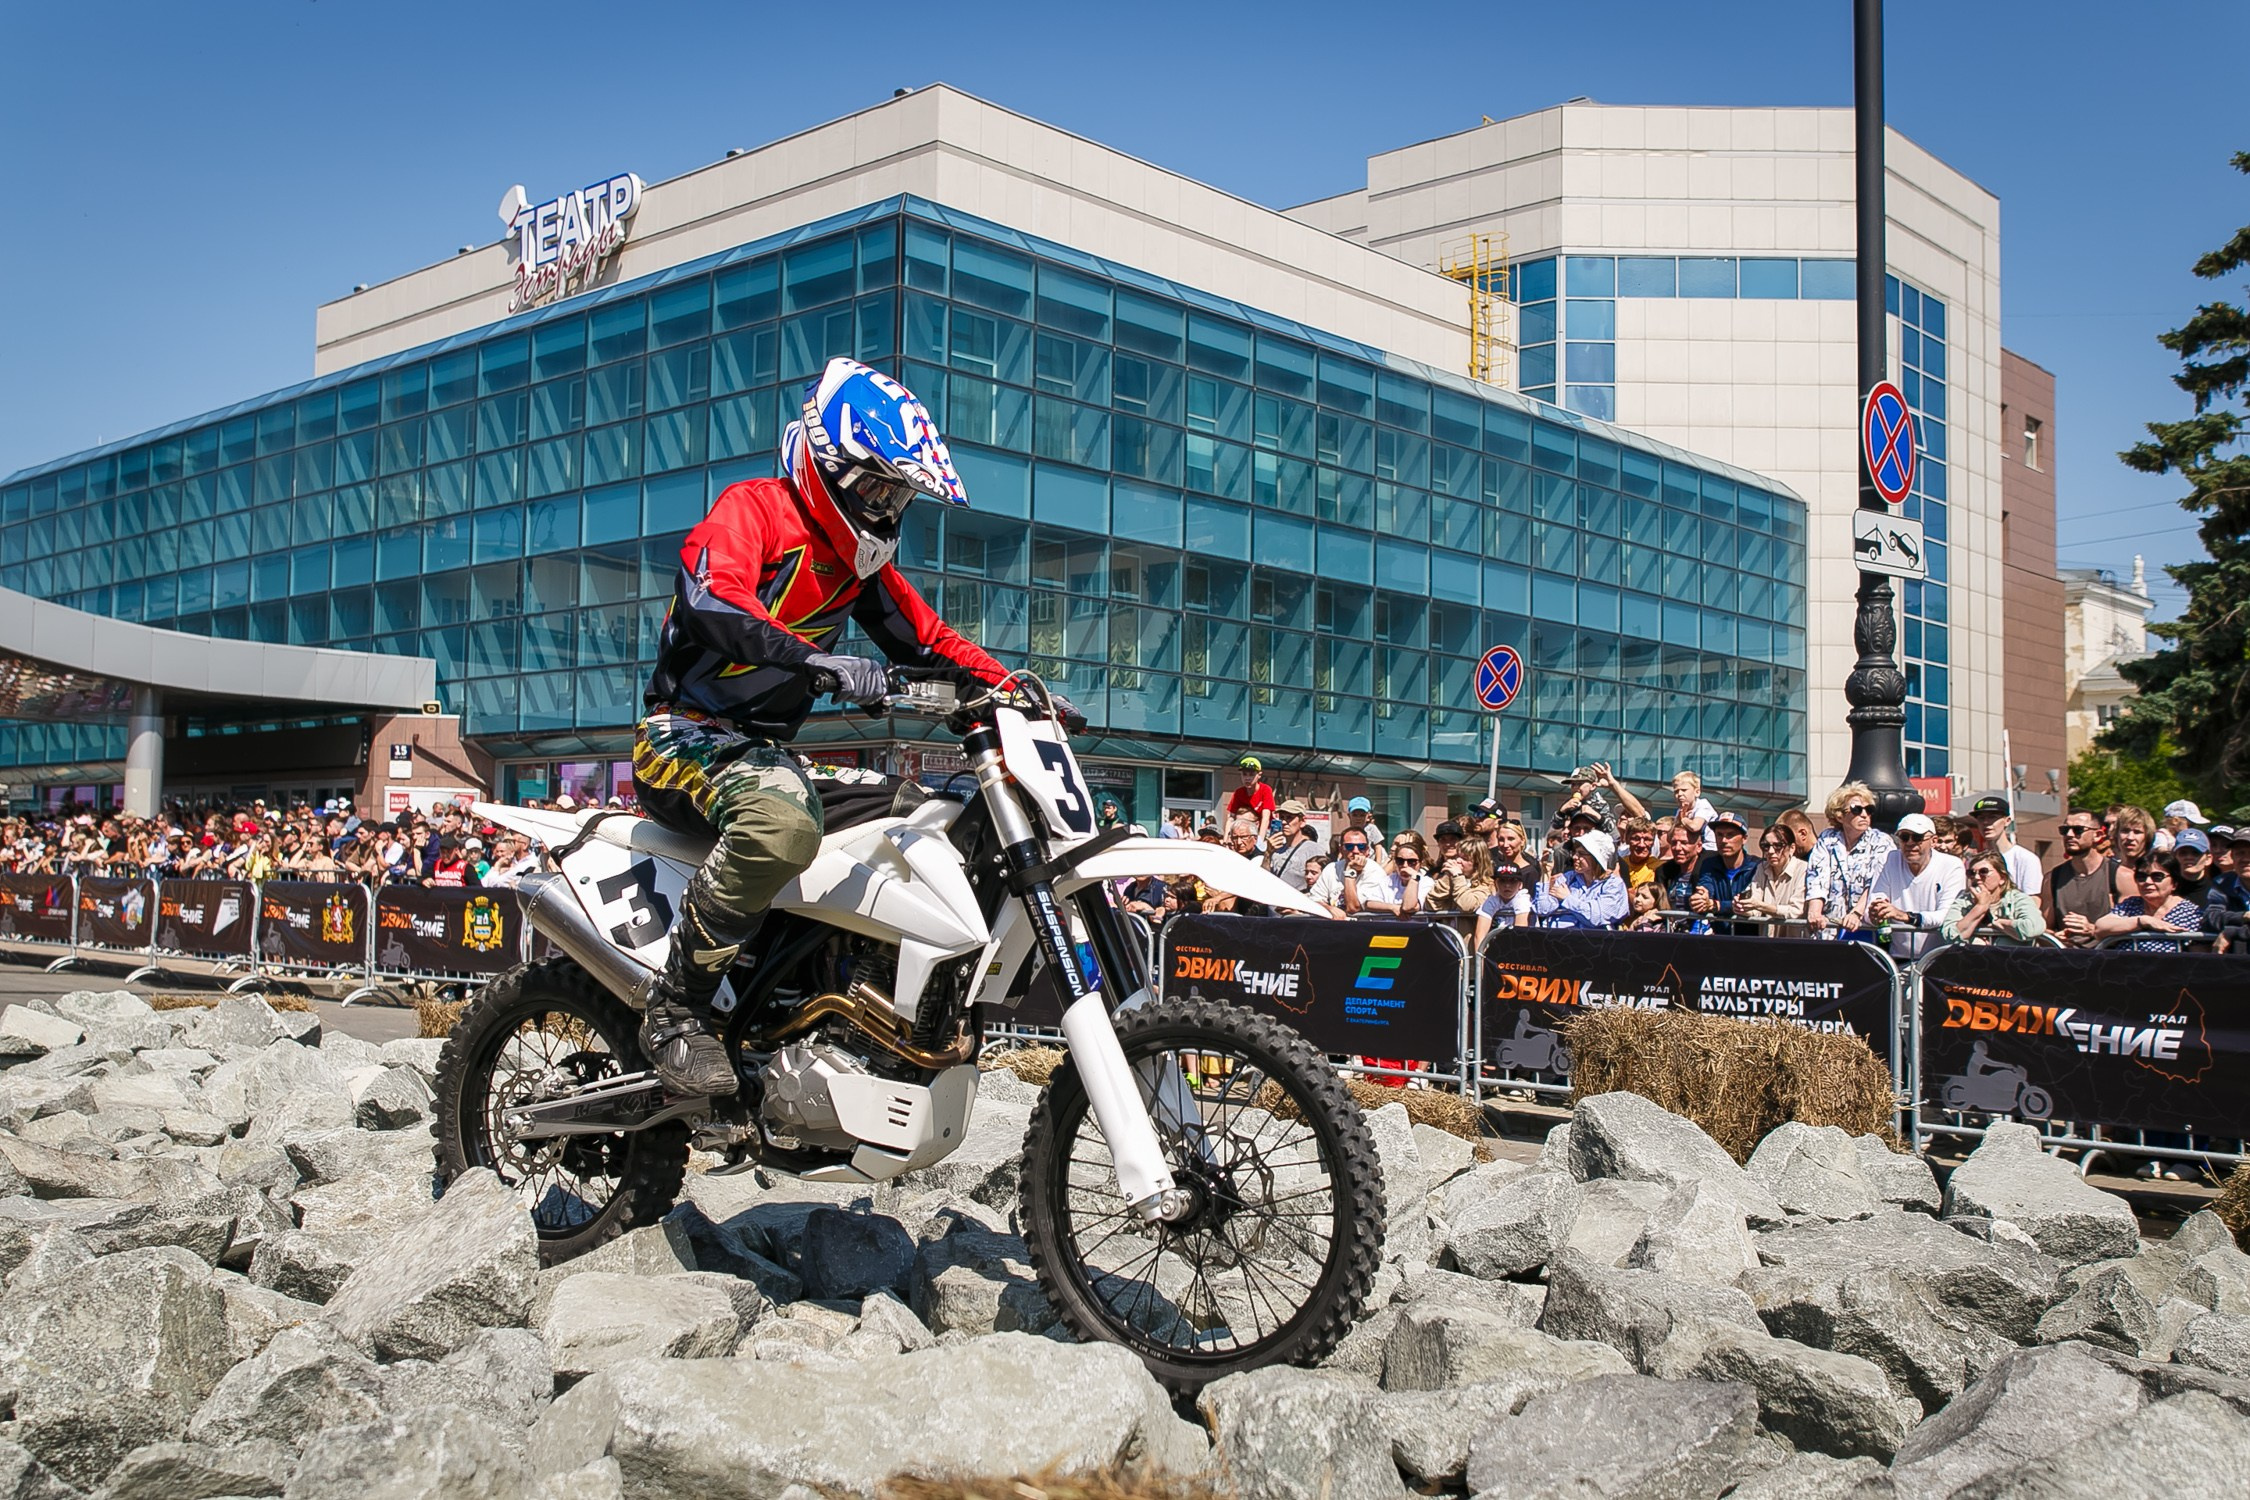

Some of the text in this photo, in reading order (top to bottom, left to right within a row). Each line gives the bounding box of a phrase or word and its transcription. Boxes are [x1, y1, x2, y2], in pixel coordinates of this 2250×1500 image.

[513, 173, 637, 266] ТЕАТР
[802, 396, 846, 473] 100%
[896, 461, 946, 497] Airoh
[393, 745, 408, 756] 15
[1031, 738, 1092, 834] 3
[1262, 776, 1344, 818] АССА
[596, 857, 675, 950] 3
[1025, 893, 1059, 965] SERVICE
[1037, 890, 1085, 997] SUSPENSION
[1280, 962, 1301, 971] УРАЛ
[1497, 963, 1548, 973] ФЕСТИВАЛЬ
[1643, 985, 1670, 994] УРАЛ
[1700, 976, 1844, 999] ДЕПАРТАМЕНТ
[1944, 985, 2014, 999] ФЕСТИВАЛЬ
[1345, 997, 1406, 1009] ДЕПАРТАМЕНТ
[1345, 1006, 1378, 1016] СПОРТА
[1700, 994, 1804, 1016] КУЛЬТУРЫ
[2149, 1014, 2188, 1025] УРАЛ
